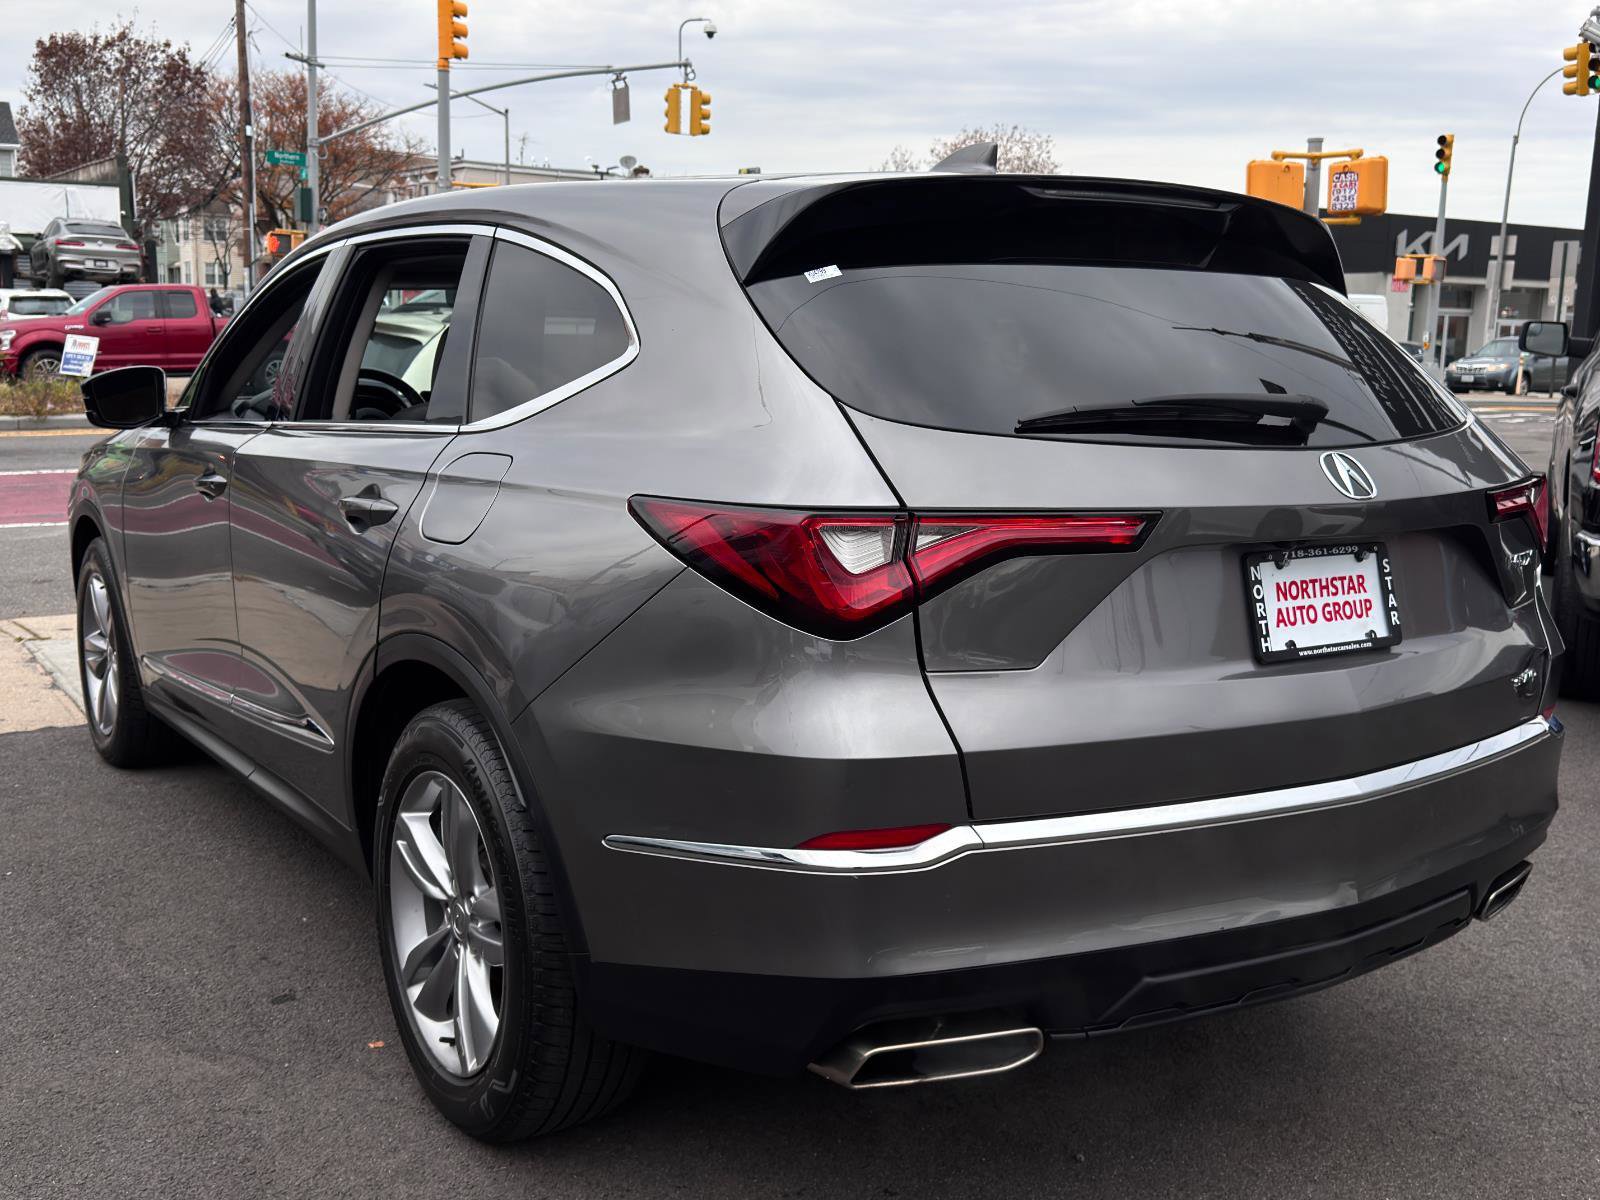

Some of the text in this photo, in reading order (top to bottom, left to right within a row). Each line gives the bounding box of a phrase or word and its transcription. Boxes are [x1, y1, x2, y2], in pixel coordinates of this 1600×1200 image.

[1333, 172, 1358, 183] CASH
[1282, 546, 1359, 559] 718-361-6299
[1275, 574, 1367, 602] NORTHSTAR
[1382, 558, 1400, 626] STAR
[1250, 566, 1272, 652] NORTH
[1275, 598, 1373, 628] AUTO GROUP
[1298, 642, 1372, 656] www.northstarcarsales.com
